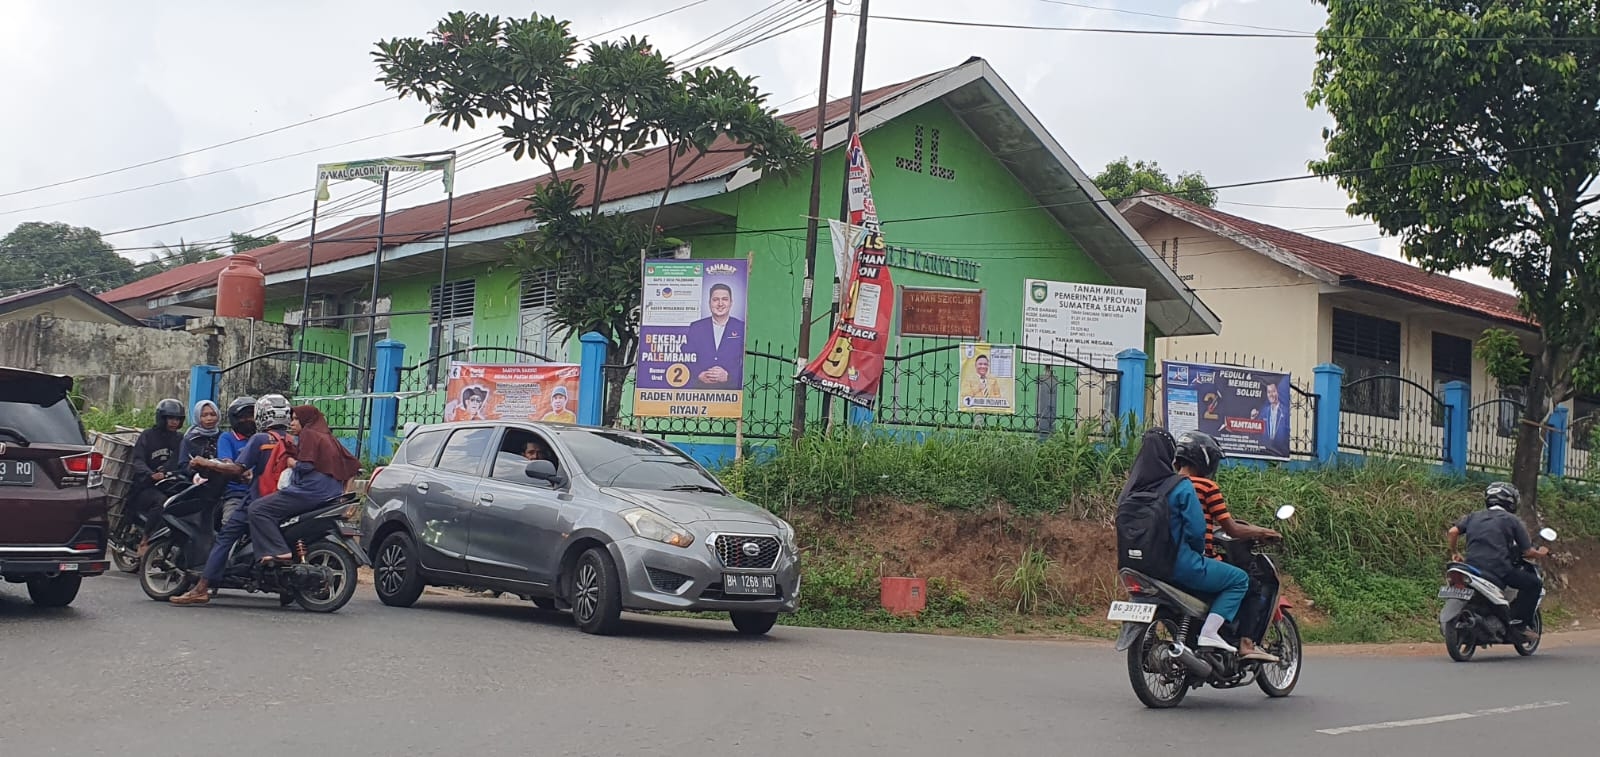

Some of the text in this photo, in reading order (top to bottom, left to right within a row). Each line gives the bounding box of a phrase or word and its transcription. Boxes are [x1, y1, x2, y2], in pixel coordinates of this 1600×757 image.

[349, 167, 375, 177] CALON
[656, 289, 661, 297] 5
[1073, 285, 1124, 296] TANAH MILIK
[1054, 292, 1143, 306] PEMERINTAH PROVINSI
[1059, 301, 1138, 314] SUMATERA SELATAN
[645, 334, 688, 345] BEKERJA
[651, 344, 682, 353] UNTUK
[642, 352, 697, 362] PALEMBANG
[673, 367, 683, 383] 2
[1220, 370, 1245, 379] PEDULI
[1228, 379, 1260, 388] MEMBERI
[640, 391, 738, 403] RADEN MUHAMMAD
[1236, 387, 1262, 397] SOLUSI
[669, 405, 707, 415] RIYAN Z
[1230, 420, 1262, 430] TAMTAMA
[727, 575, 737, 587] BH
[741, 575, 758, 588] 1268
